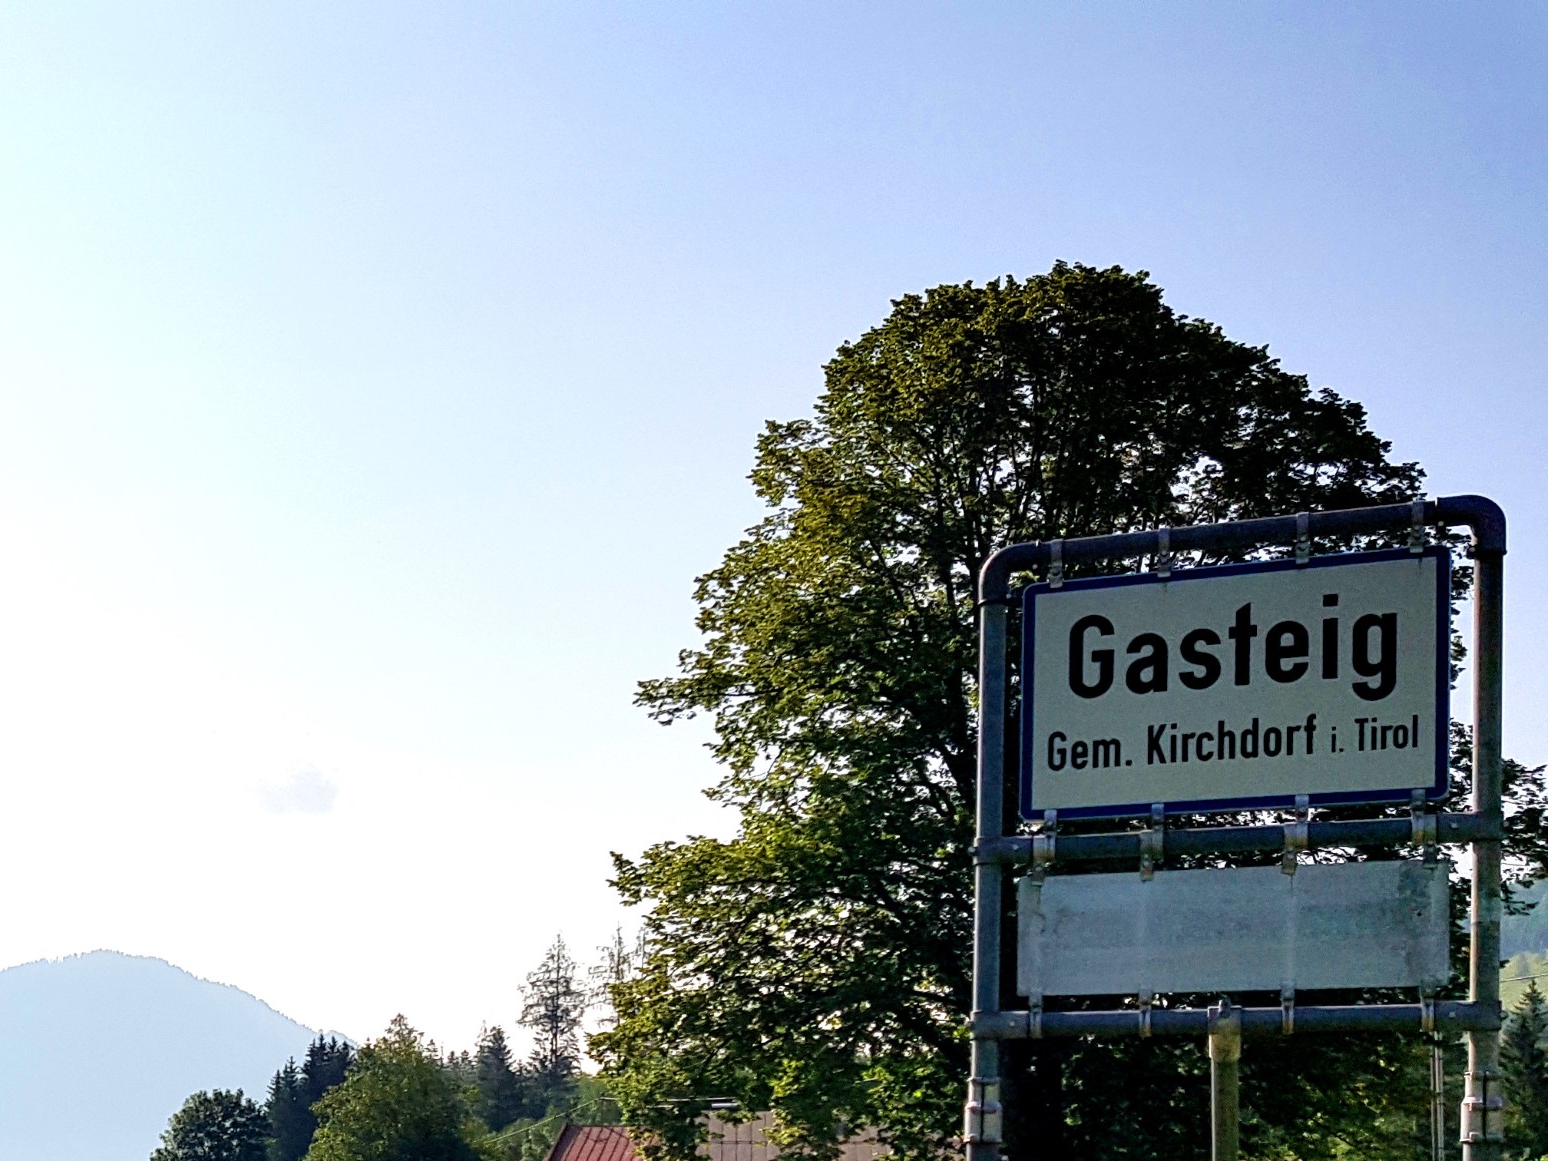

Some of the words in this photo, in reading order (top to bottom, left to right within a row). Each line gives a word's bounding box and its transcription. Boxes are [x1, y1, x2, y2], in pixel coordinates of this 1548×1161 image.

[1068, 593, 1397, 701] Gasteig
[1047, 731, 1133, 771] Gem.
[1146, 713, 1317, 766] Kirchdorf
[1330, 725, 1345, 754] i.
[1354, 714, 1420, 753] Tirol
